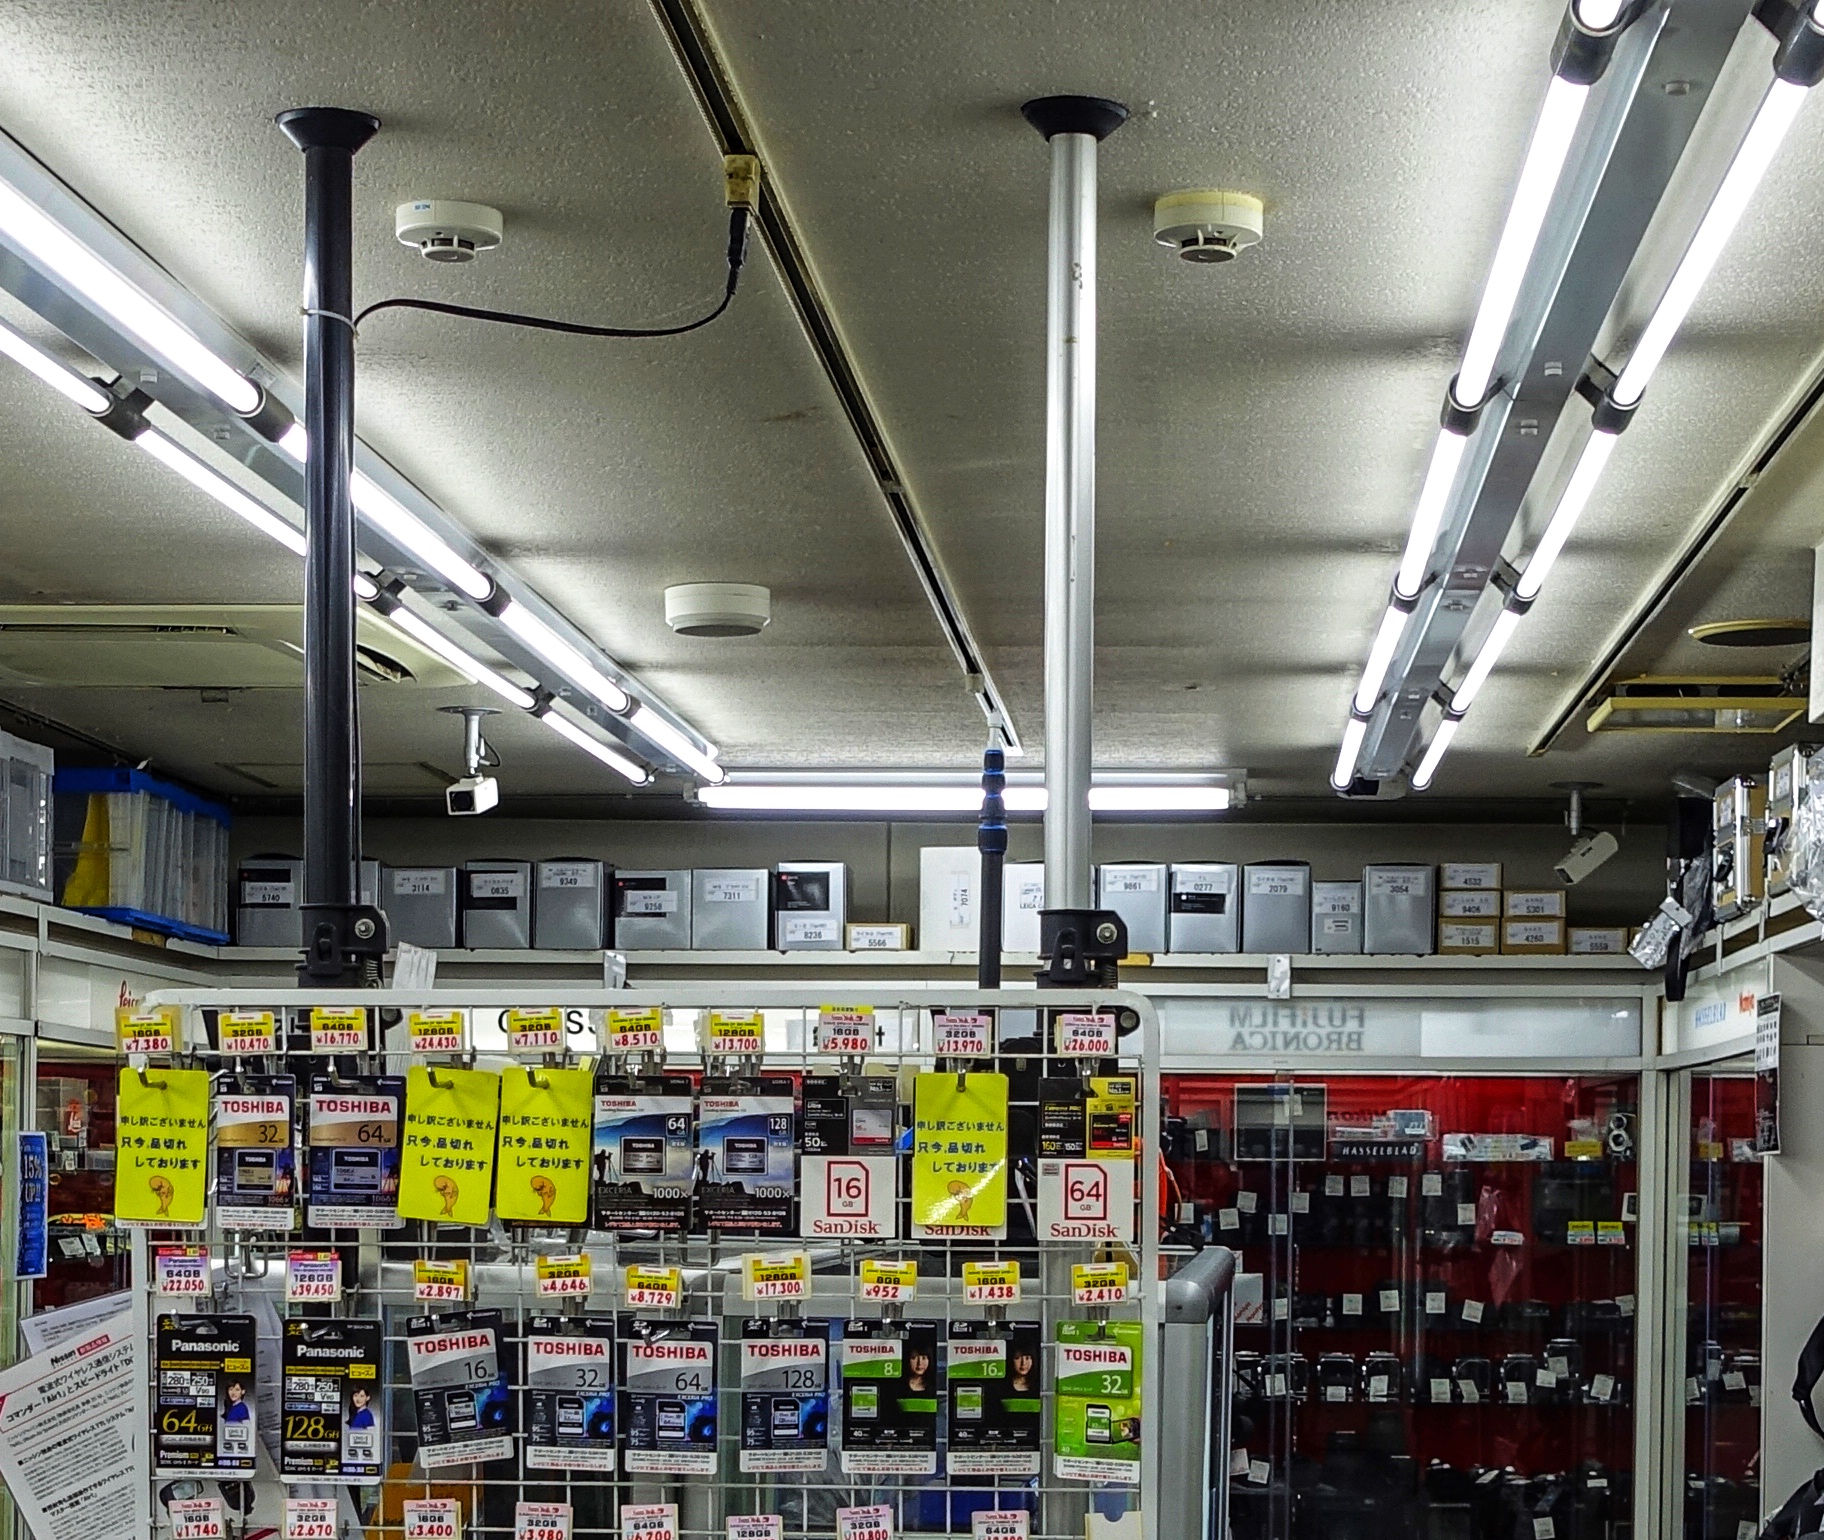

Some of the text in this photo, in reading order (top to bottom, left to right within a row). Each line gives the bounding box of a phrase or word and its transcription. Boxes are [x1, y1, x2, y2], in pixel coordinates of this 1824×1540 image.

[221, 1099, 285, 1116] TOSHIBA
[316, 1099, 392, 1116] TOSHIBA
[600, 1099, 638, 1108] TOSHIBA
[704, 1099, 740, 1109] TOSHIBA
[119, 1115, 207, 1131] 申し訳ございません
[407, 1114, 495, 1132] 申し訳ございません
[501, 1114, 590, 1131] 申し訳ございません
[916, 1119, 1005, 1135] 申し訳ございません
[1342, 1143, 1420, 1157] HASSELBLAD
[134, 1156, 202, 1171] しております
[420, 1155, 489, 1172] しております
[515, 1155, 585, 1171] しております
[832, 1178, 862, 1199] 16
[1069, 1180, 1103, 1200] 64
[812, 1218, 880, 1237] SanDisk
[1050, 1222, 1118, 1240] SanDisk
[171, 1339, 240, 1353] Panasonic
[296, 1345, 365, 1359] Panasonic
[414, 1333, 491, 1355] TOSHIBA
[533, 1340, 606, 1358] TOSHIBA
[632, 1343, 709, 1360] TOSHIBA
